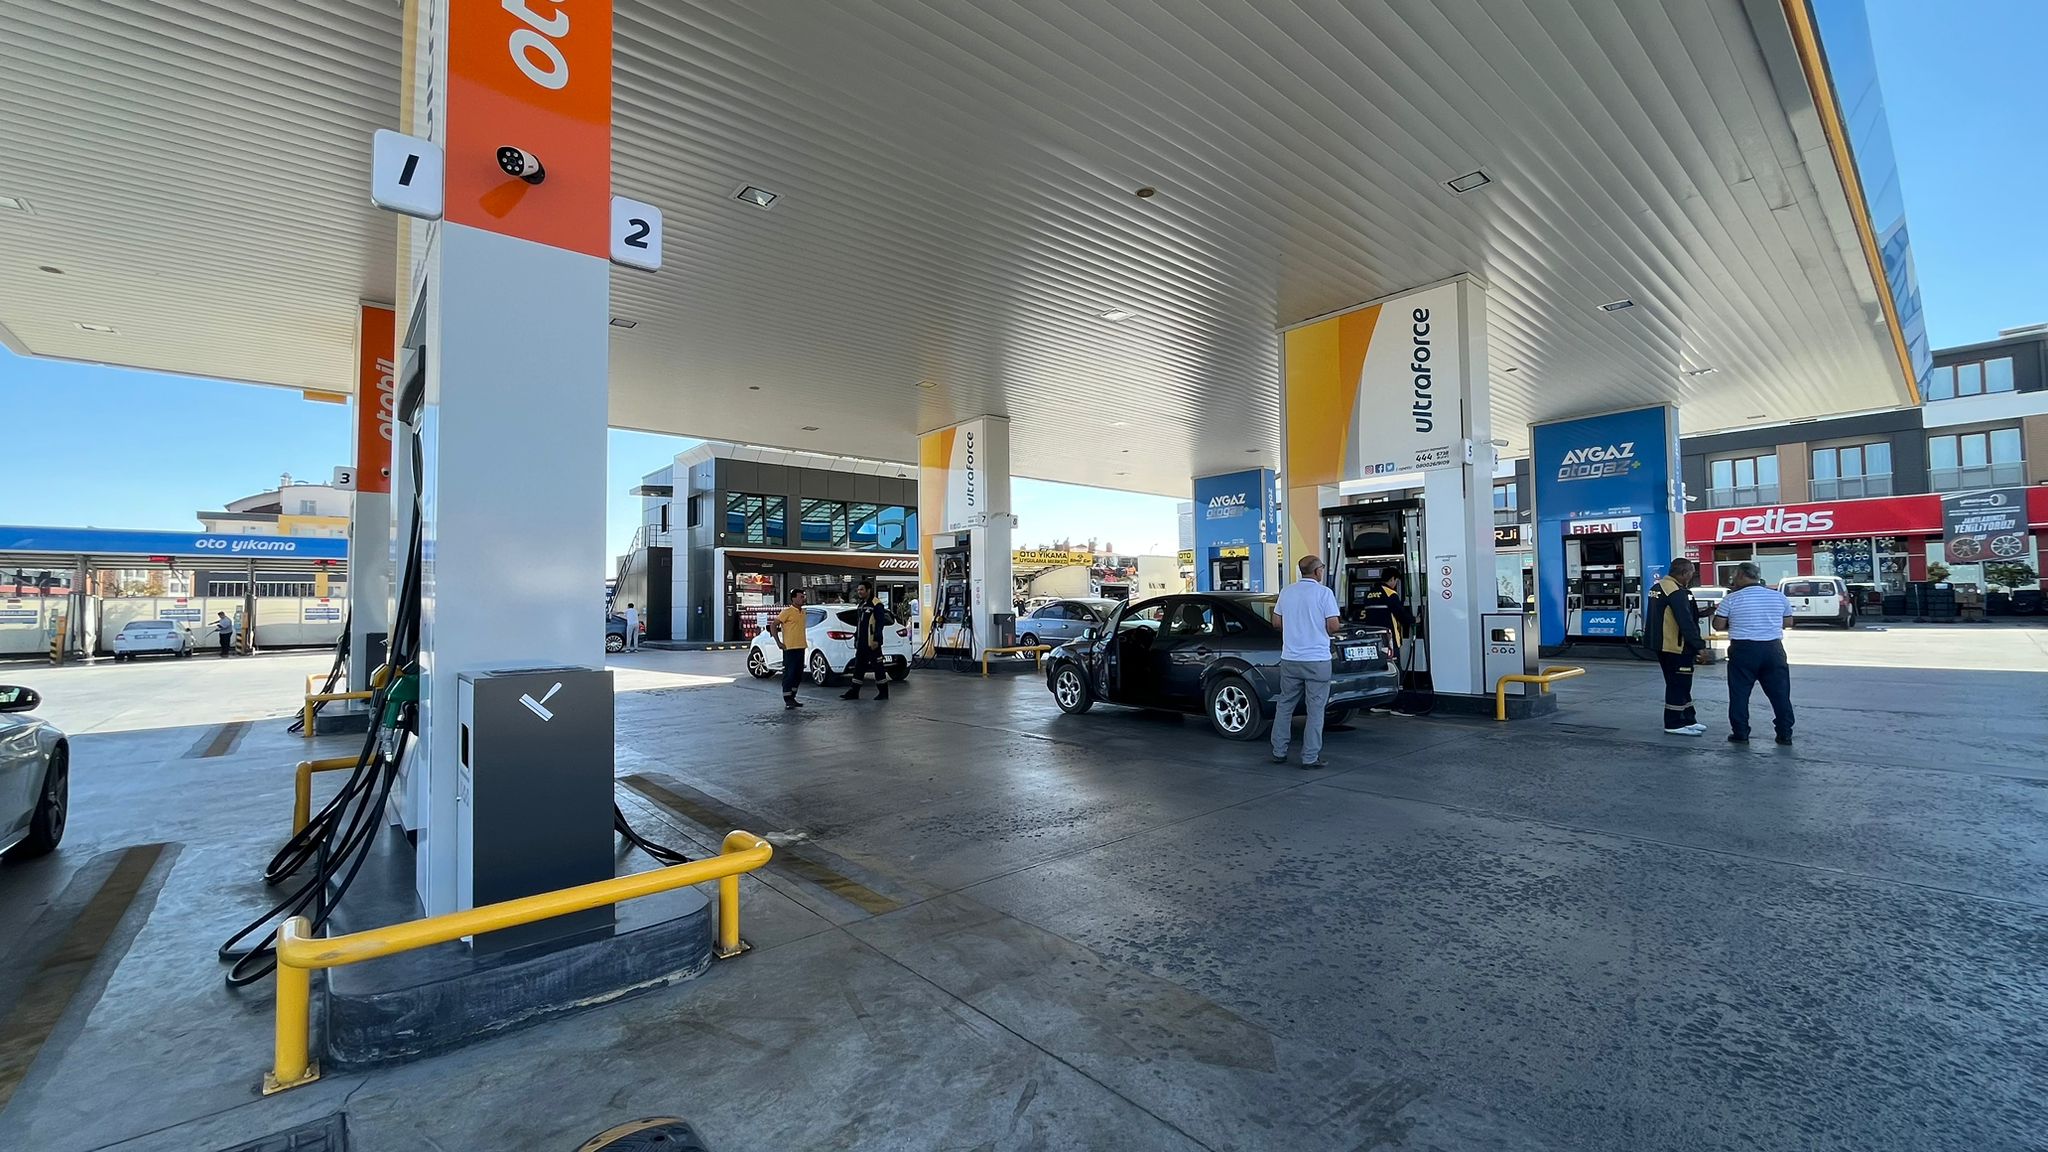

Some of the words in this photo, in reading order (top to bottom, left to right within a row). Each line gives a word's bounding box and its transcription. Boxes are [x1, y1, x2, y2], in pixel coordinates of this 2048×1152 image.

[398, 154, 419, 187] 1
[623, 218, 650, 249] 2
[1410, 308, 1433, 433] ultraforce
[1415, 453, 1433, 462] 444
[1468, 445, 1473, 457] 5
[1561, 442, 1635, 466] AYGAZ
[965, 431, 975, 507] ultraforce
[339, 472, 351, 484] 3
[1208, 493, 1246, 508] AYGAZ
[981, 515, 987, 523] 7
[1715, 508, 1834, 542] petlas
[195, 538, 227, 549] oto
[231, 539, 296, 552] yıkama
[1039, 551, 1068, 559] YIKAMA
[1178, 552, 1192, 560] OTO
